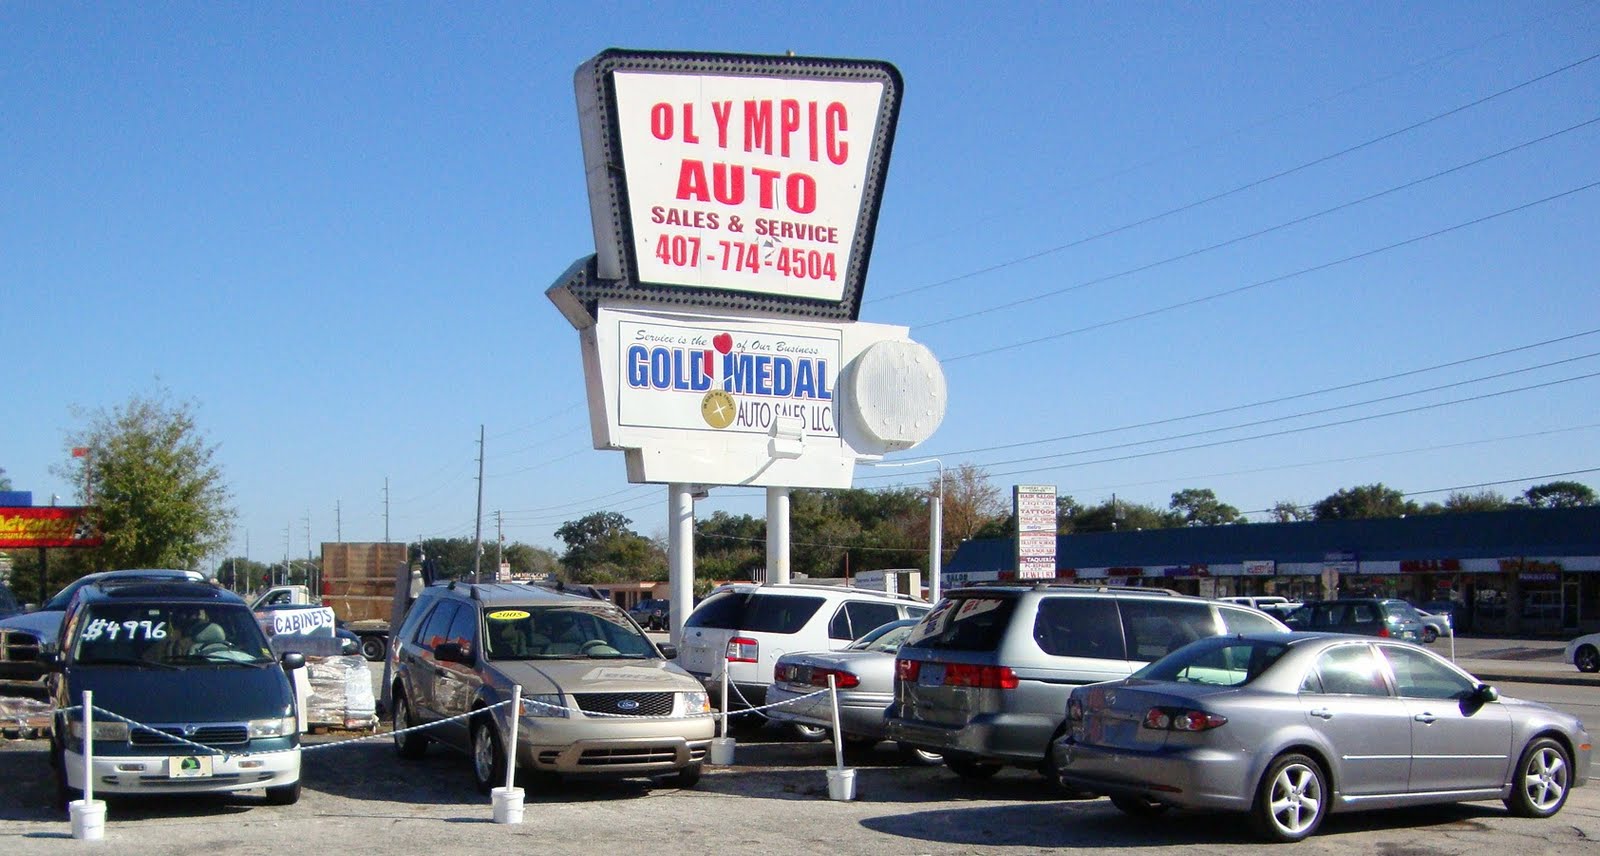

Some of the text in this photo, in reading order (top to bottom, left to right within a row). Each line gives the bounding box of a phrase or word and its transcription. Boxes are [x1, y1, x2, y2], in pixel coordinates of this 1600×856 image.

[650, 99, 849, 165] OLYMPIC
[675, 159, 817, 214] AUTO
[651, 206, 839, 244] SALES & SERVICE
[655, 234, 837, 281] 407-774-4504
[635, 330, 819, 355] Service is the of Our Business
[627, 344, 833, 400] GOLD MEDAL
[737, 401, 770, 429] AUTO
[812, 406, 834, 432] LLC.
[275, 609, 333, 634] CABINETS
